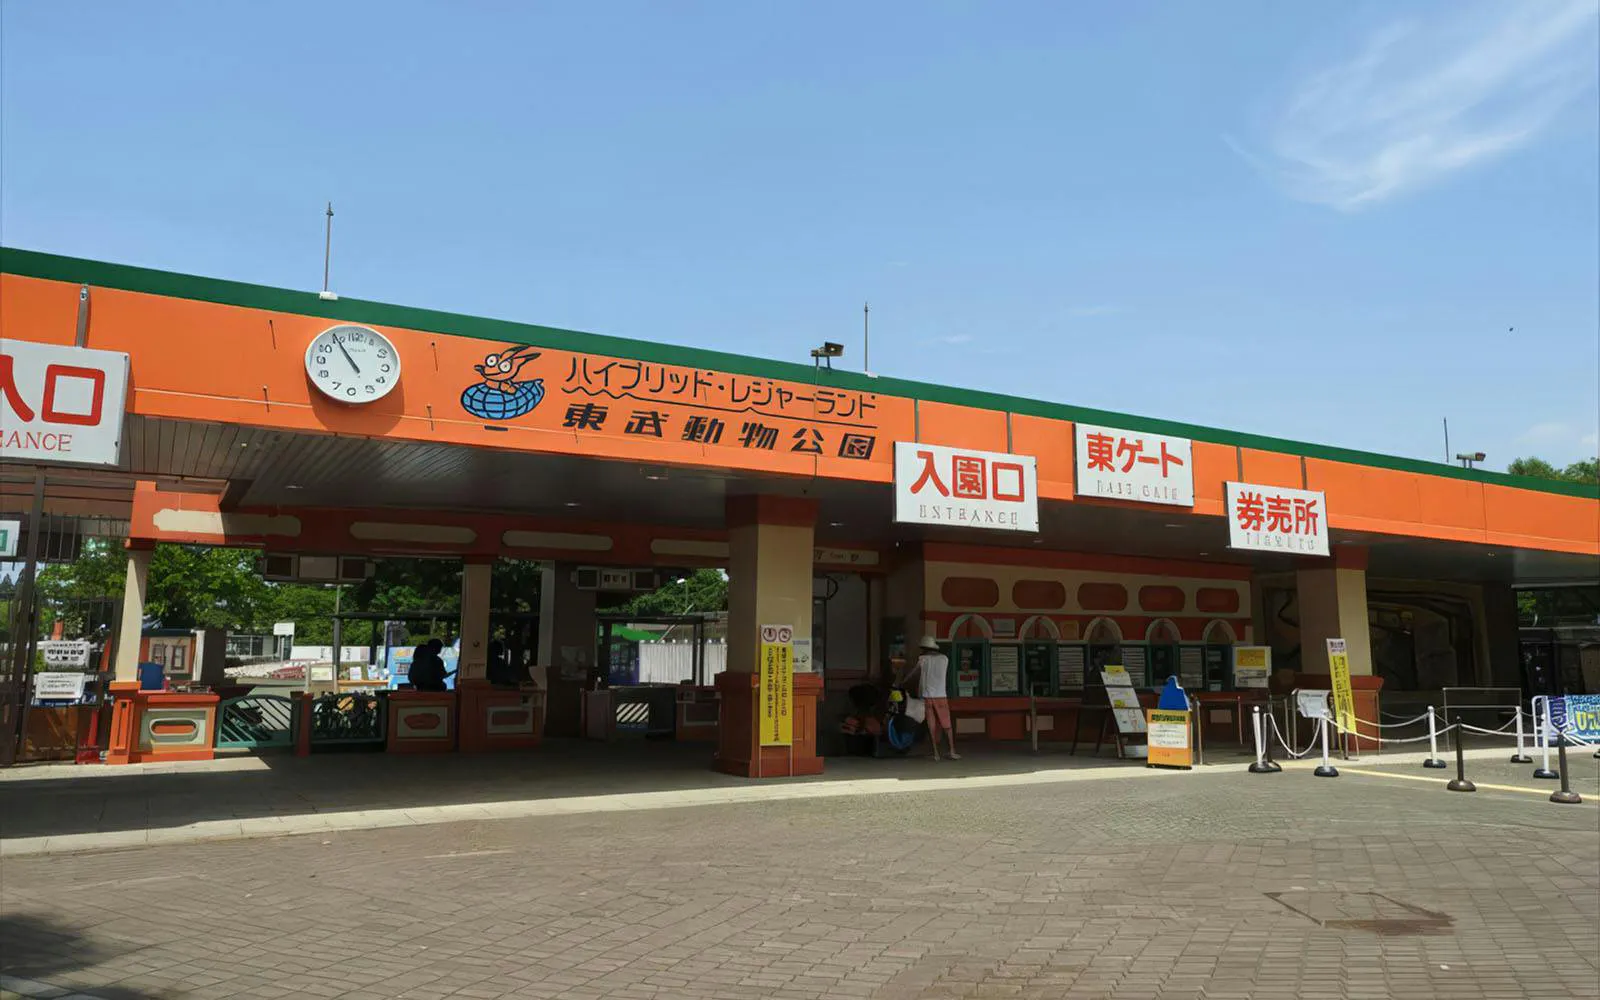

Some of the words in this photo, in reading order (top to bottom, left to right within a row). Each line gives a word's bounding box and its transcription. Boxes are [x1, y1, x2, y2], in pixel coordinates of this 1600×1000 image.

[565, 356, 876, 419] ハイブリッド・レジャーランド
[0, 430, 72, 452] ANCE
[562, 403, 876, 460] 東武動物公園
[1086, 432, 1184, 478] 東ゲート
[910, 451, 1025, 502] 入園口
[1237, 491, 1319, 536] 券売所
